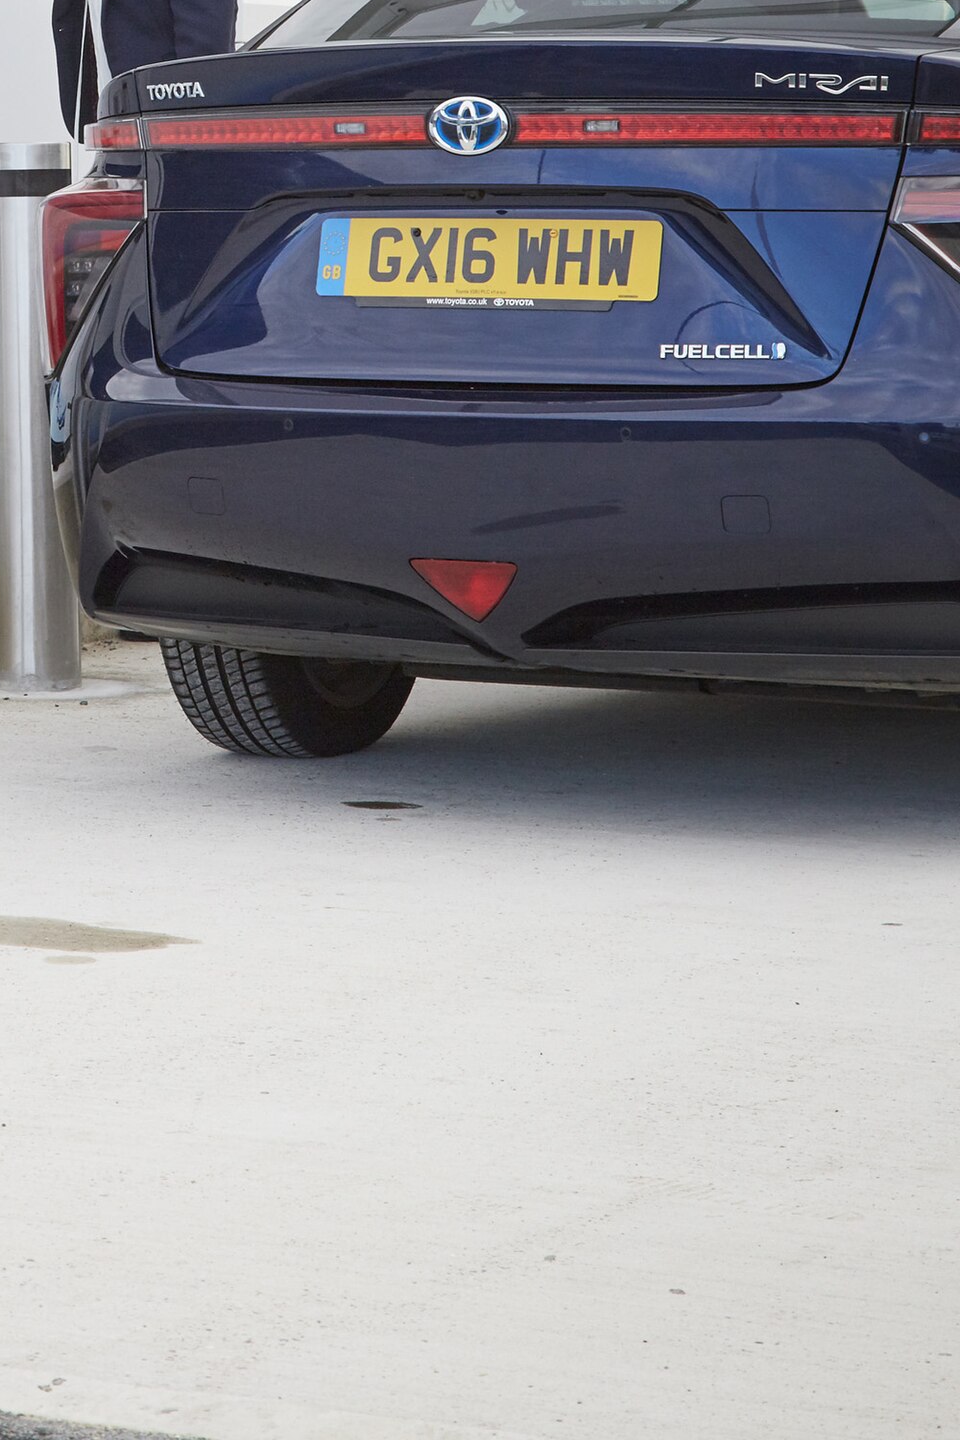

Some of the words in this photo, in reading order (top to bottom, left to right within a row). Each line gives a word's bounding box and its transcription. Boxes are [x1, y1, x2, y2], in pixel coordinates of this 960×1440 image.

[146, 81, 205, 101] TOYOTA
[755, 72, 889, 95] MIRAI
[368, 227, 497, 284] GX16
[516, 228, 635, 287] WHW
[322, 265, 342, 281] GB
[426, 297, 488, 306] www.toyota.co.uk
[504, 299, 535, 307] TOYOTA
